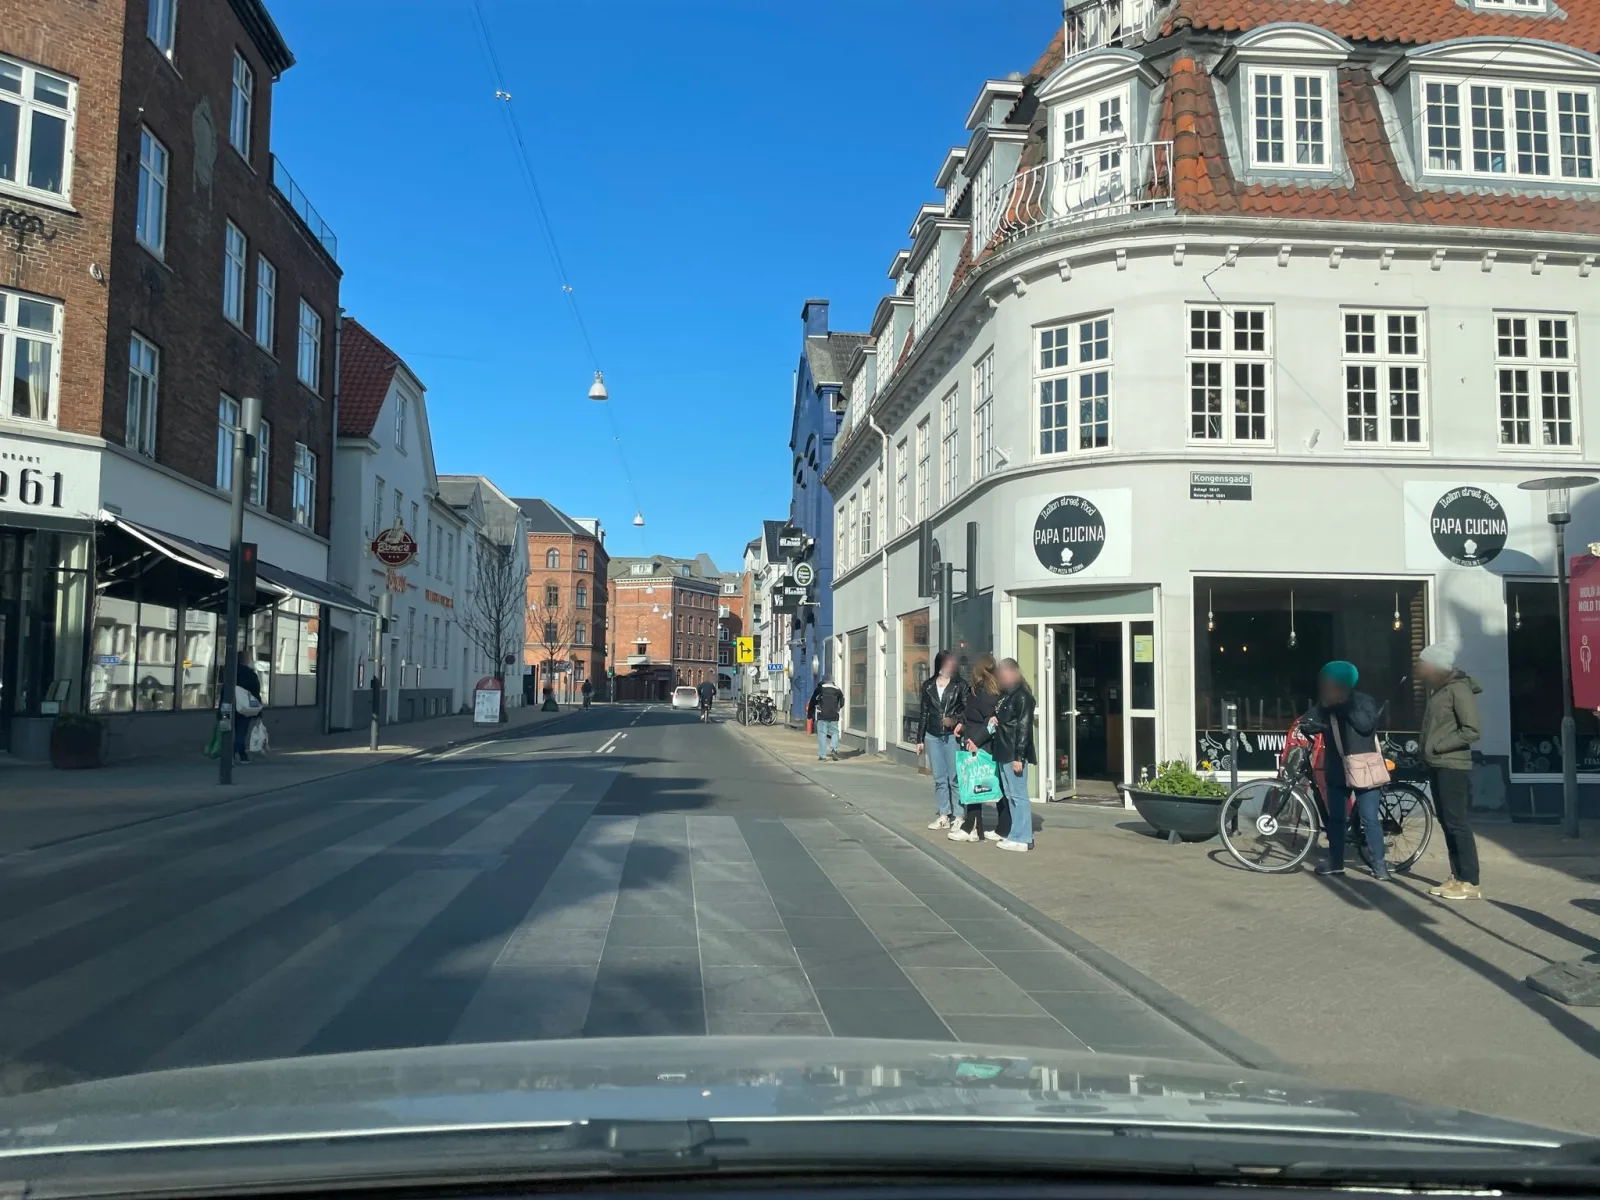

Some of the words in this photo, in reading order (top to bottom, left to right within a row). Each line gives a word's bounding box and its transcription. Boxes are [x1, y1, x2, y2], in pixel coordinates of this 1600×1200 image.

[1194, 474, 1249, 484] Kongensgade
[1439, 490, 1461, 509] Italian
[1461, 487, 1481, 499] street
[1482, 493, 1499, 510] food
[1040, 500, 1060, 520] Italian
[1060, 497, 1080, 507] street
[1081, 500, 1097, 517] food
[1035, 528, 1060, 545] PAPA
[1062, 525, 1105, 543] CUCINA
[1432, 518, 1462, 534] PAPA
[1465, 518, 1508, 535] CUCINA
[378, 541, 411, 552] Bone's
[1578, 600, 1594, 612] HOLD
